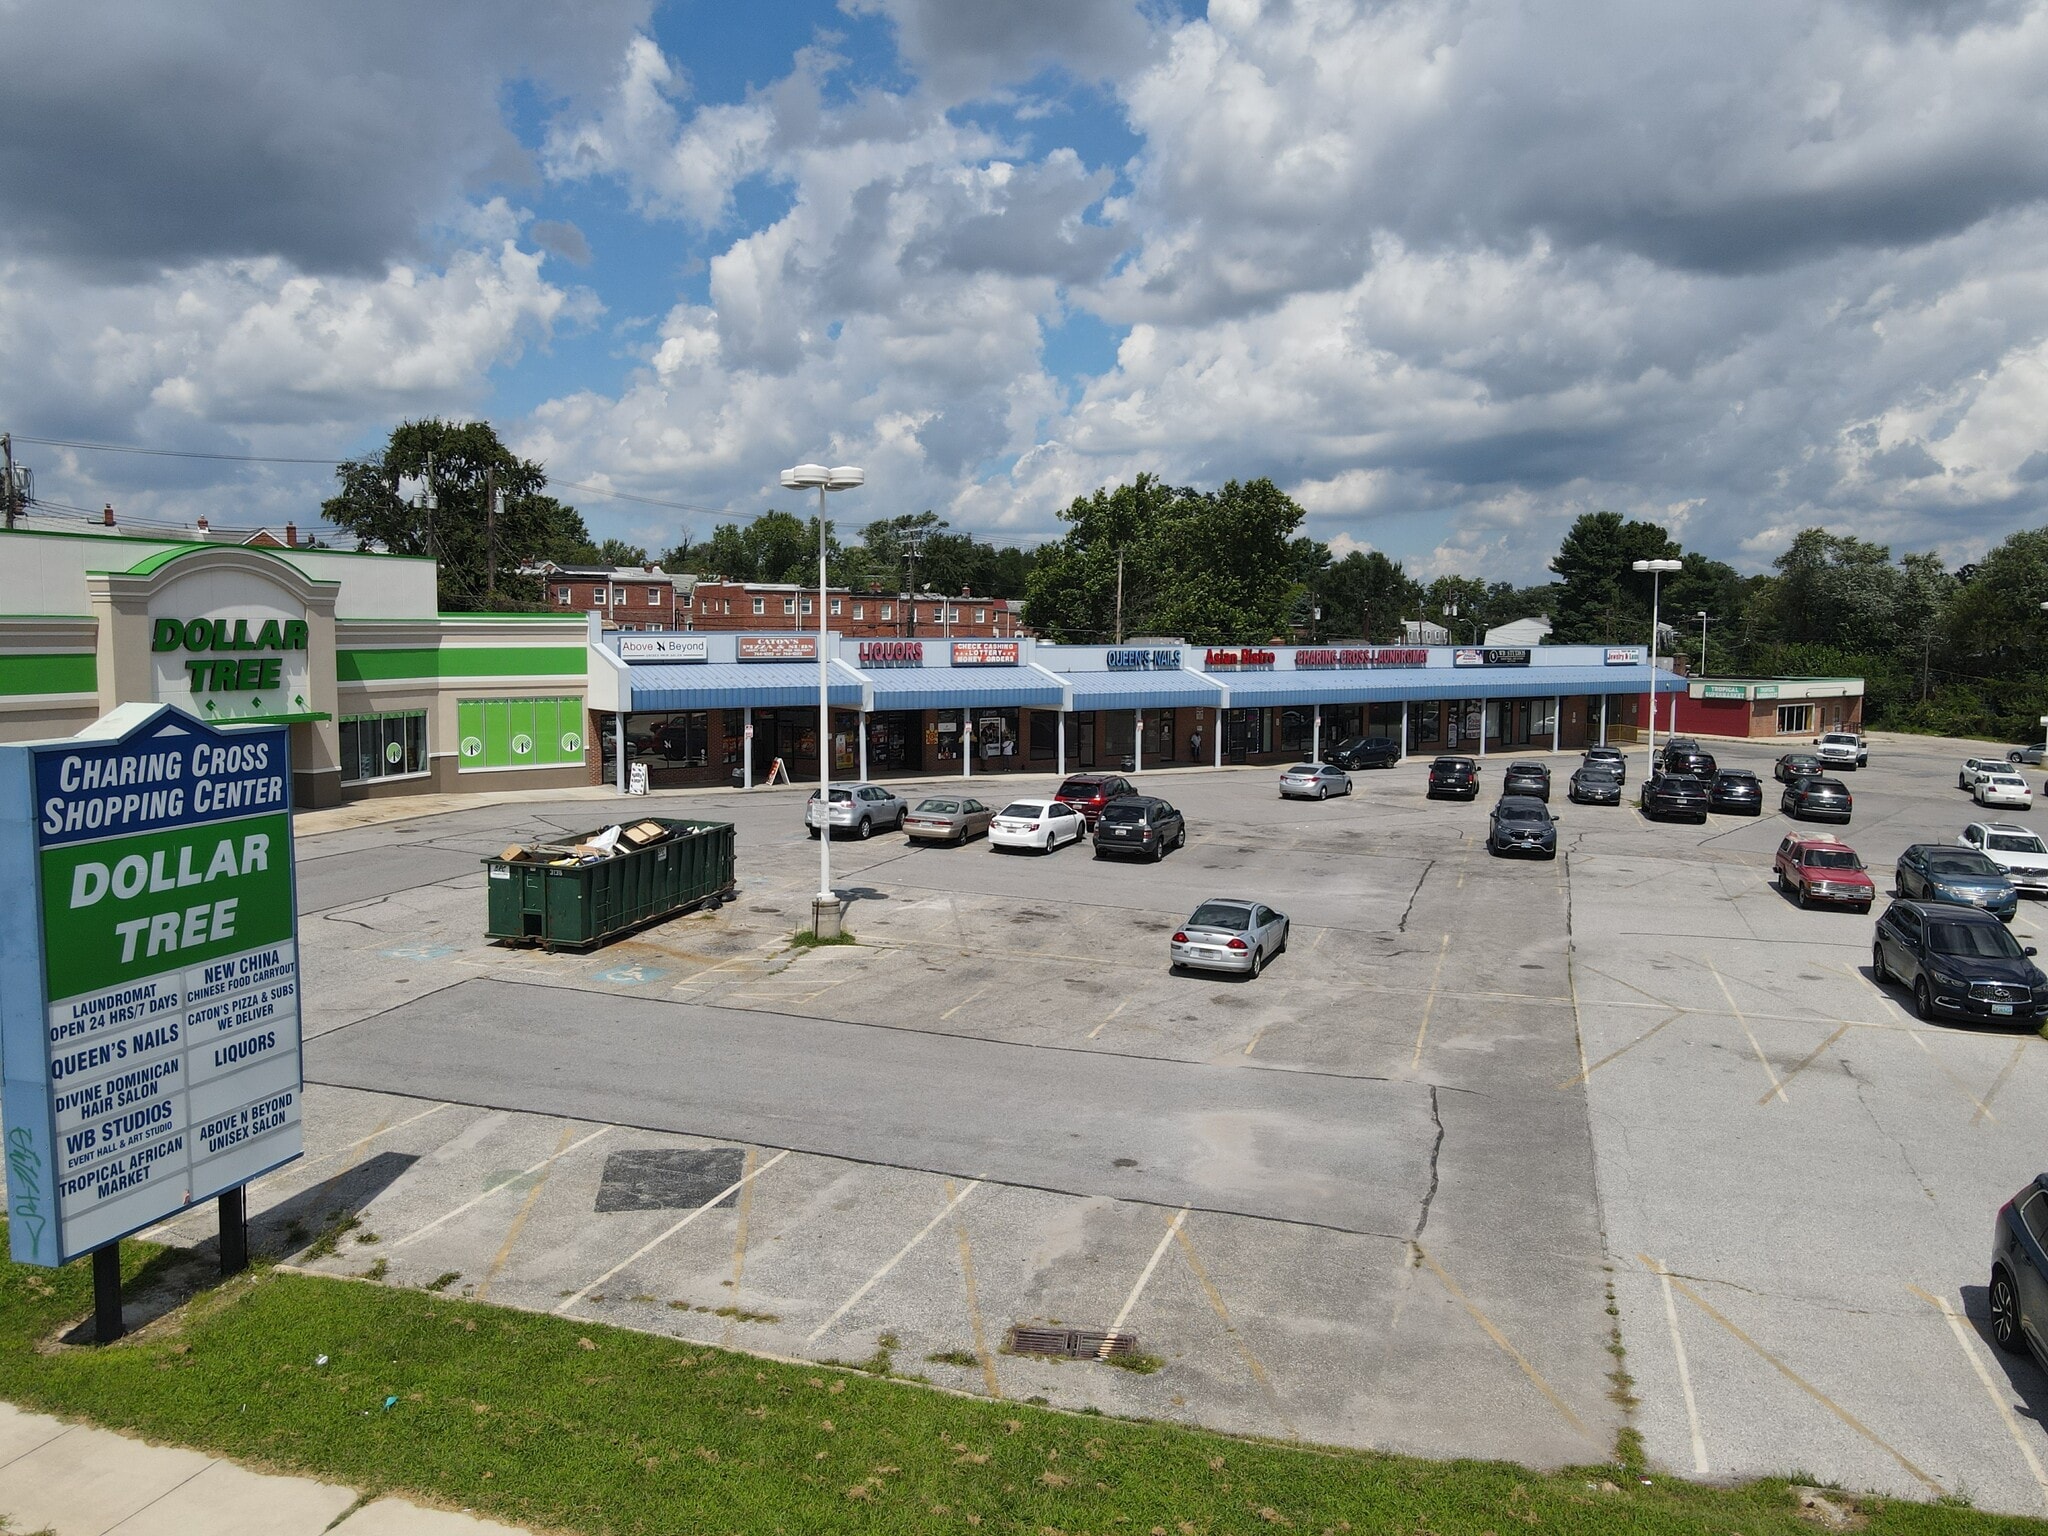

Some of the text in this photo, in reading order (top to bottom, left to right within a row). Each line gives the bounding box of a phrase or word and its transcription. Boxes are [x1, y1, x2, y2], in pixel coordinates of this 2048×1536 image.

[152, 618, 308, 652] DOLLAR
[623, 642, 653, 650] Above
[669, 642, 704, 652] Beyond
[859, 642, 922, 662] LIQUORS
[185, 658, 282, 692] TREE
[1107, 650, 1181, 666] QUEEN'S NAILS
[1205, 649, 1276, 664] Asian Bistro
[1296, 650, 1428, 664] CHARING CROSS LAUNDROMAT
[60, 743, 269, 792] CHARING CROSS
[43, 776, 283, 834] SHOPPING CENTER
[70, 833, 270, 909] DOLLAR
[115, 898, 238, 963] TREE
[187, 962, 295, 1002] CHINESE FOOD CARRYOUT
[204, 950, 279, 984] NEW CHINA
[50, 994, 178, 1042] OPEN 24 HRS/7 DAYS
[73, 984, 156, 1018] LAUNDROMAT
[188, 984, 294, 1026] CATON'S PIZZA & SUBS
[218, 1004, 274, 1030] WE DELIVER
[52, 1024, 179, 1080] QUEEN'S NAILS
[215, 1031, 275, 1067] LIQUORS
[56, 1058, 179, 1113] DIVINE DOMINICAN
[82, 1081, 158, 1120] HAIR SALON
[66, 1100, 172, 1154] WB STUDIOS
[200, 1093, 292, 1141] ABOVE N BEYOND
[209, 1110, 285, 1152] UNISEX SALON
[68, 1121, 172, 1168] EVENT HALL & ART STUDIO
[60, 1136, 182, 1198] TROPICAL AFRICAN
[98, 1166, 150, 1199] MARKET
